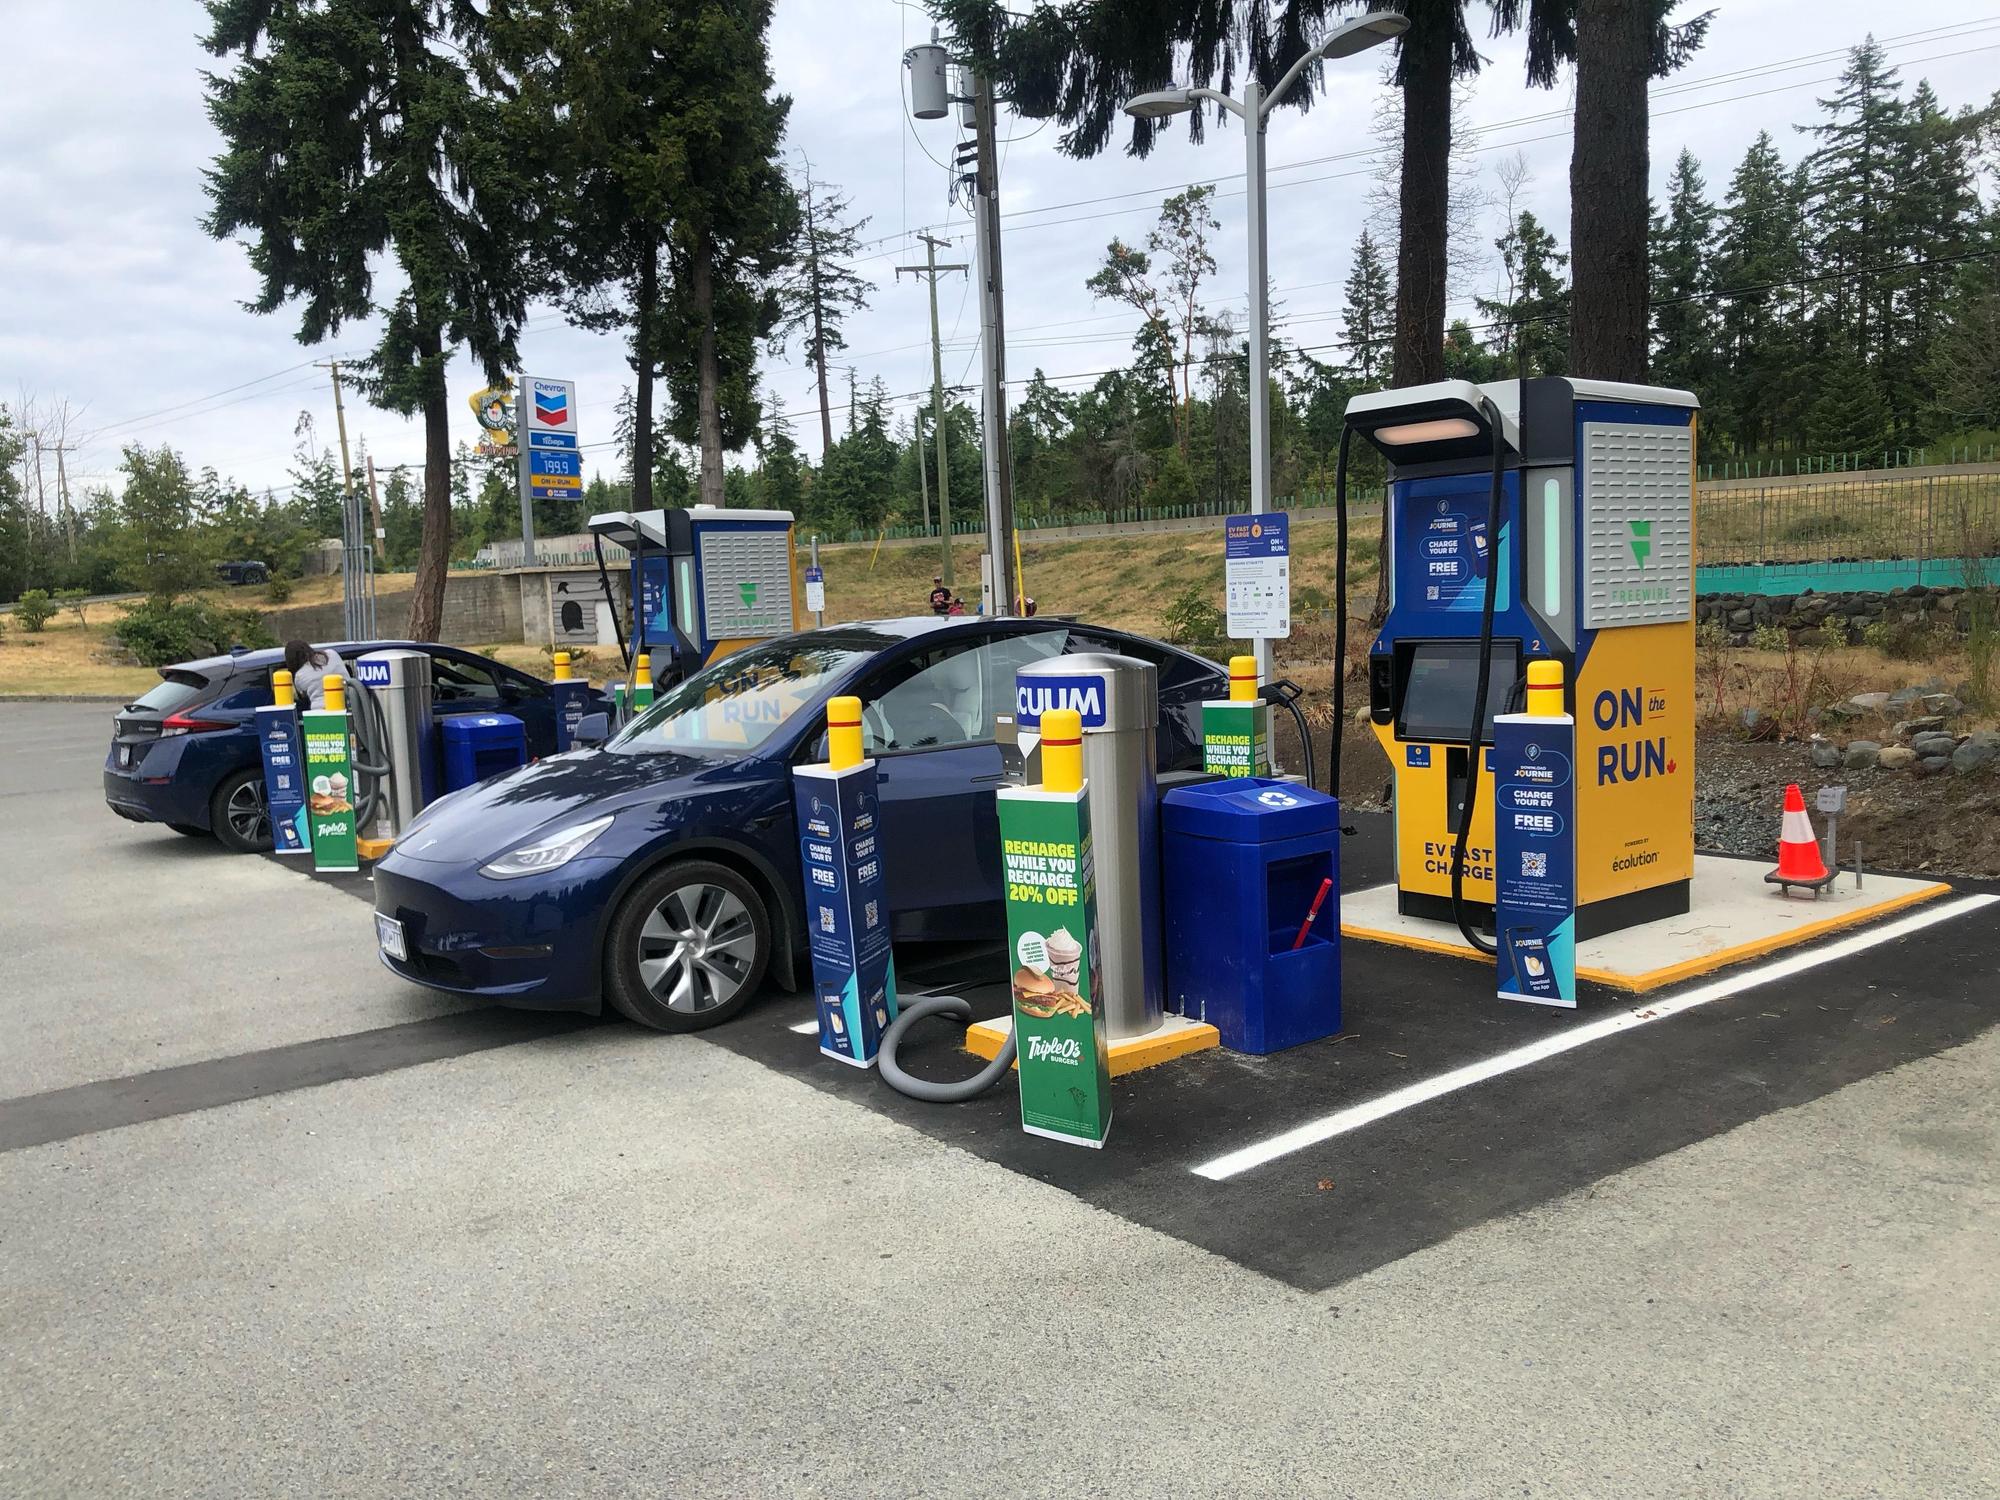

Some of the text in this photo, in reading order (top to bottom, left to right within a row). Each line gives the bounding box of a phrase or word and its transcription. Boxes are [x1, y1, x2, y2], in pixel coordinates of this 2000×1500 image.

[534, 381, 566, 393] Chevron
[544, 460, 569, 474] 199.9
[1429, 521, 1458, 530] JOURNIE
[1428, 540, 1458, 548] CHARGE
[1429, 561, 1459, 572] FREE
[1612, 587, 1670, 601] FREEWIRE
[1378, 640, 1383, 651] 1
[1532, 639, 1540, 651] 2
[1016, 686, 1101, 716] CUUM
[723, 698, 781, 723] RUN
[1594, 686, 1665, 731] ON the
[330, 740, 346, 748] YOU
[1205, 734, 1251, 745] RECHARGE
[1206, 744, 1250, 756] WHILE YOU
[271, 755, 291, 764] FREE
[308, 753, 347, 763] 20% OFF
[1206, 754, 1251, 766] RECHARGE.
[1598, 737, 1666, 787] RUN
[1207, 764, 1251, 778] 20% OFF
[1514, 769, 1554, 778] JOURNIE
[1513, 790, 1554, 800] CHARGE
[1514, 798, 1539, 806] YOUR
[1514, 814, 1554, 828] FREE
[809, 843, 832, 855] CHARGE
[855, 836, 875, 851] CHARGE
[1004, 840, 1076, 858] RECHARGE
[1425, 842, 1447, 857] EV
[810, 851, 832, 862] YOUR EV
[856, 844, 875, 859] YOUR EV
[1006, 854, 1076, 873] WHILE YOU
[1612, 850, 1658, 872] écolution
[812, 867, 835, 884] FREE
[857, 860, 878, 880] FREE
[1007, 868, 1078, 888] RECHARGE.
[1009, 883, 1078, 906] 20% OFF
[1514, 938, 1543, 948] JOURNIE
[1529, 977, 1551, 986] Download
[1050, 1055, 1079, 1066] BURGERS
